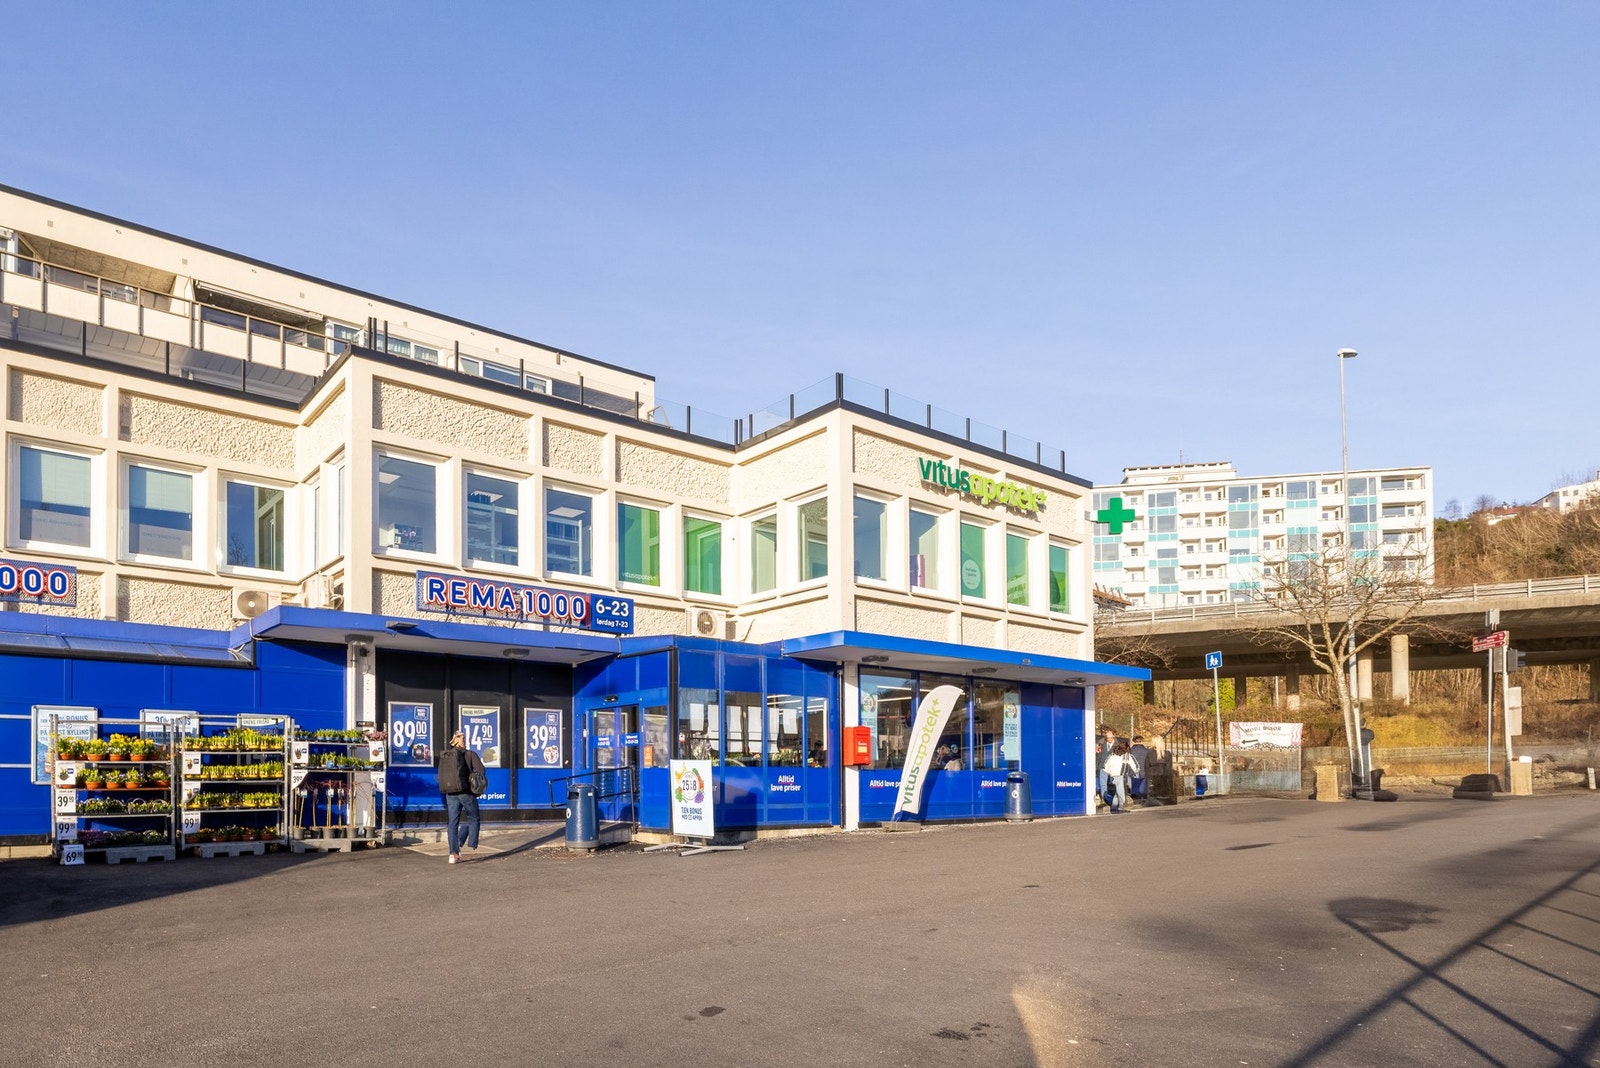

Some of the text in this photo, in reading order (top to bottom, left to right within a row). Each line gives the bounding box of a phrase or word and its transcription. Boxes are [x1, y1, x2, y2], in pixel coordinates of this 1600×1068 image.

[425, 575, 586, 620] REMA 1000
[596, 599, 629, 617] 6-23
[596, 618, 629, 628] lørdag 7-23
[393, 720, 427, 747] 89 00
[464, 724, 493, 750] 14 90
[530, 725, 557, 750] 39 90
[778, 775, 795, 783] Alltid
[682, 780, 690, 791] 25
[784, 784, 801, 792] priser
[57, 796, 68, 807] 39
[487, 792, 506, 801] priser
[689, 807, 703, 815] BONUS
[58, 823, 70, 834] 99
[184, 818, 194, 828] 99
[66, 852, 76, 863] 69
